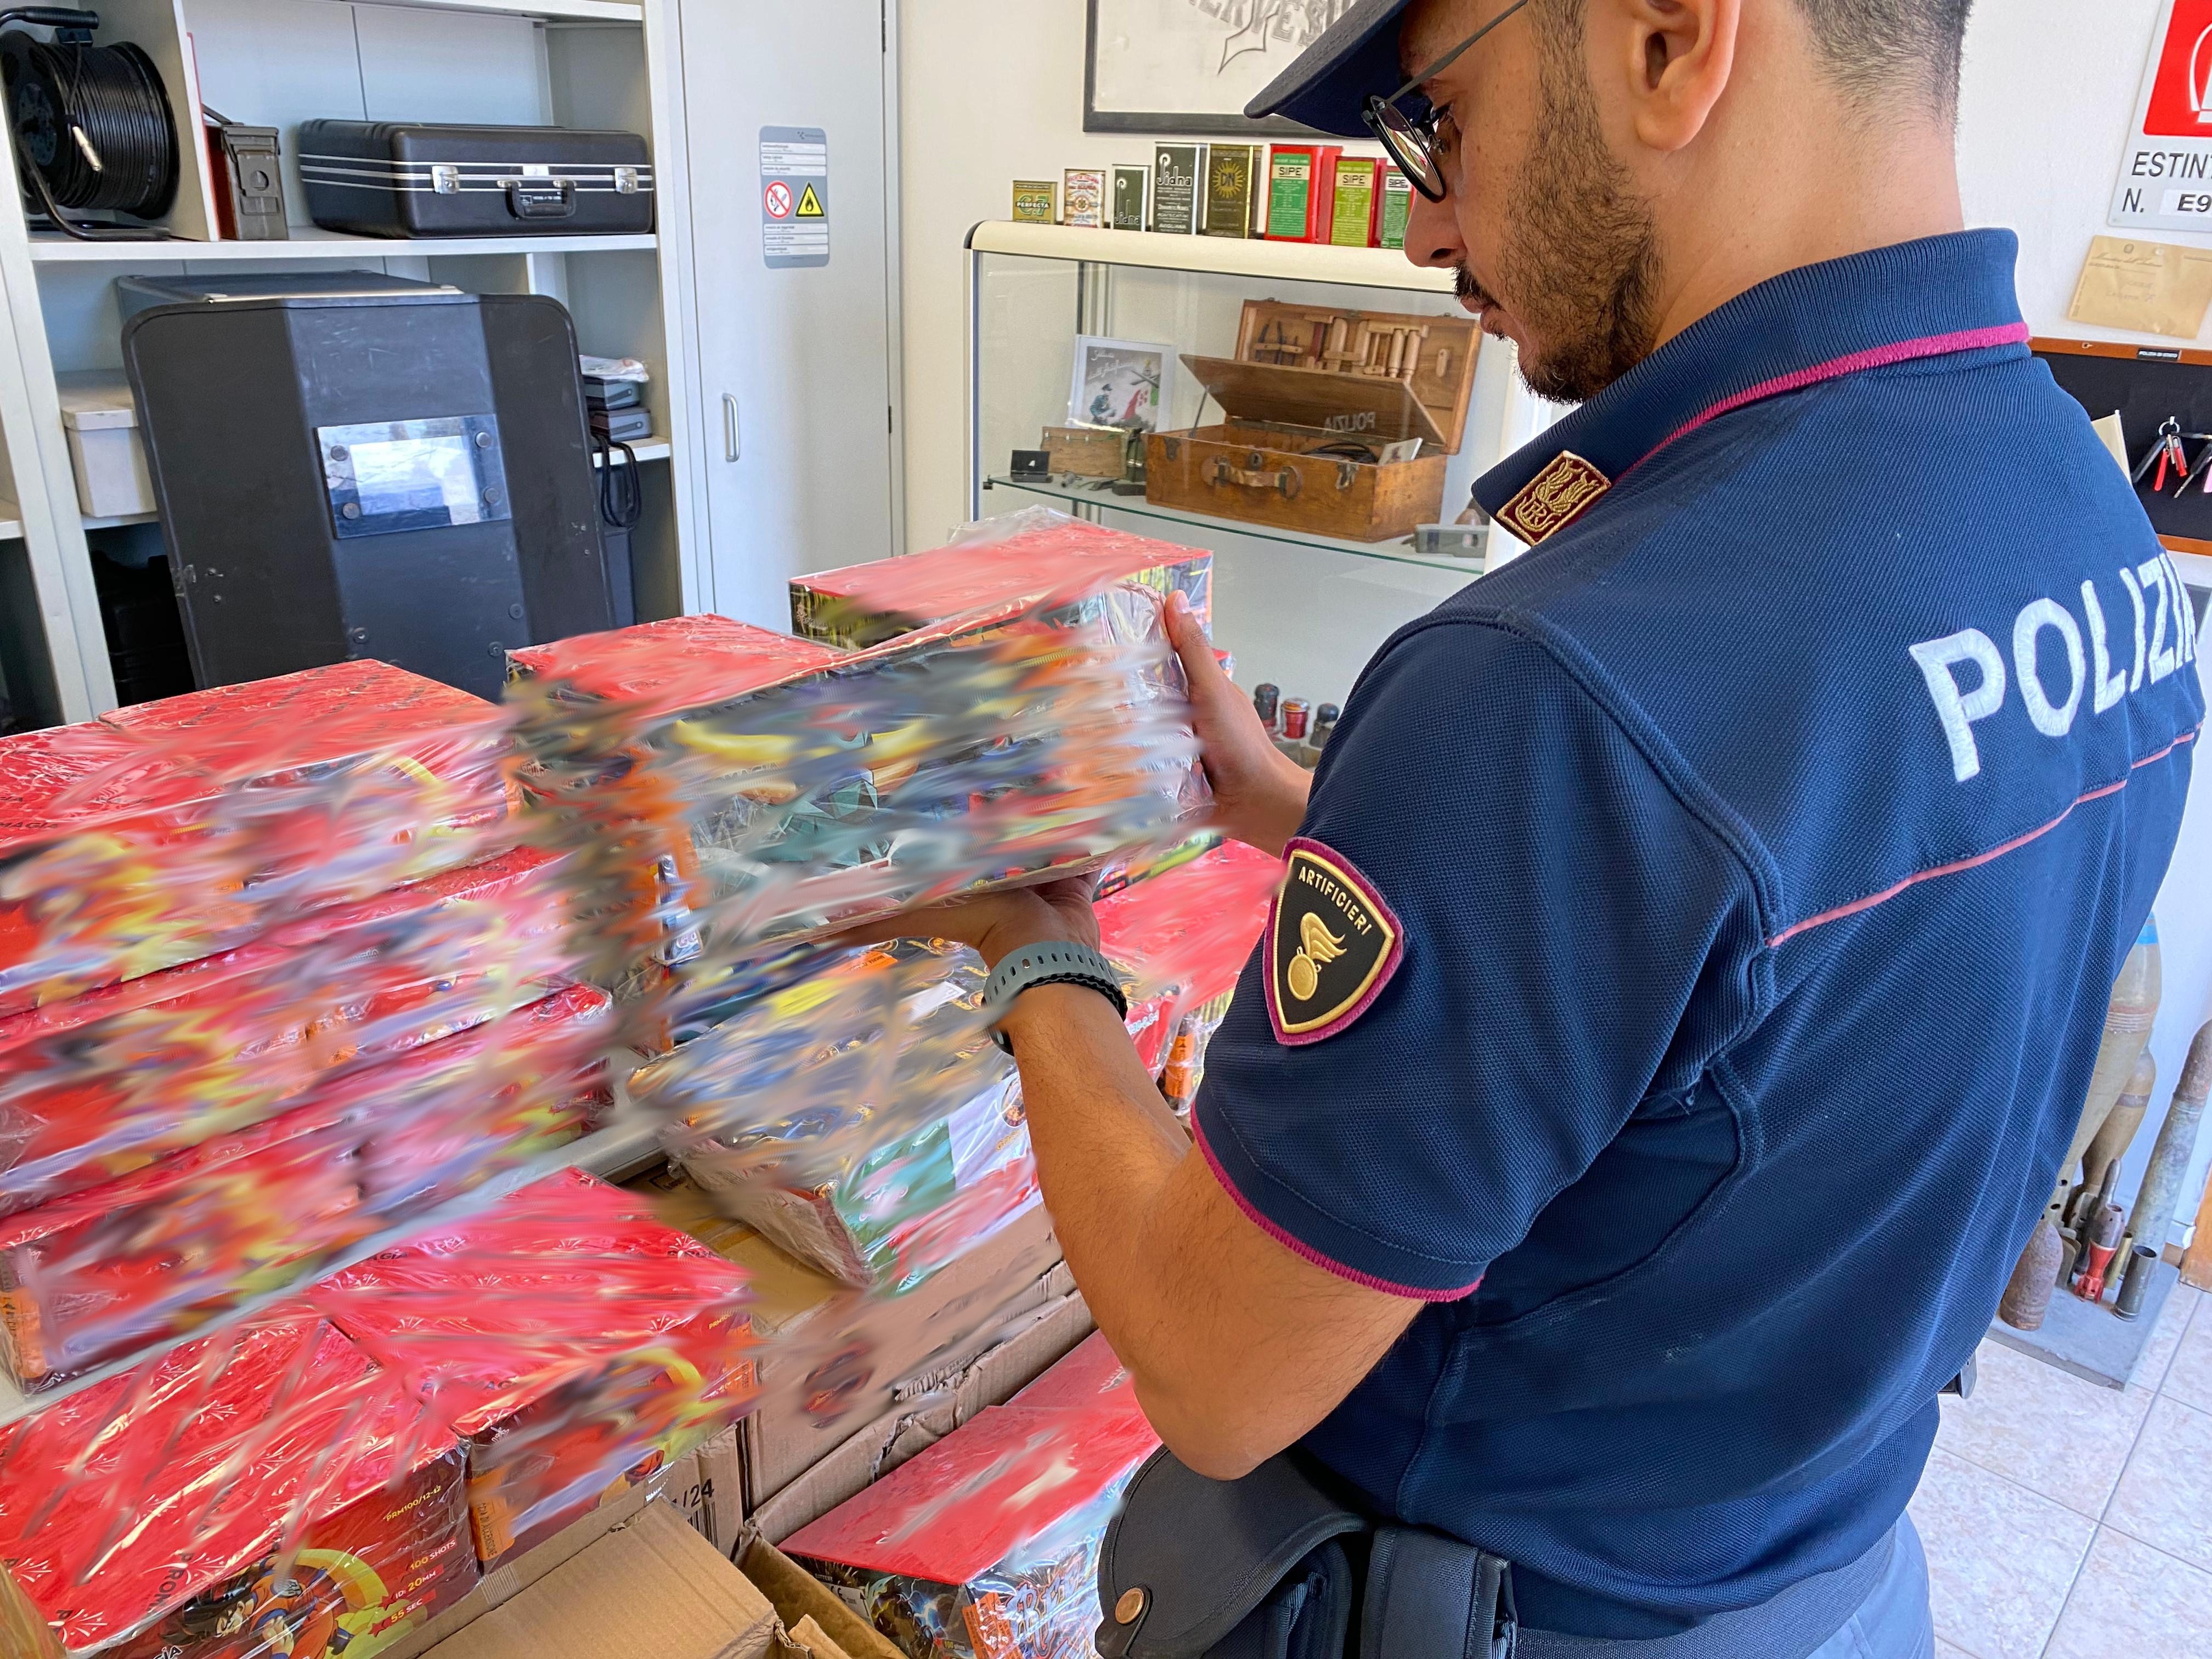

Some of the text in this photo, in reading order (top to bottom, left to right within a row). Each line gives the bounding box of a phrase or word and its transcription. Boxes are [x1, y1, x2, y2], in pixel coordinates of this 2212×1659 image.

[1279, 167, 1302, 176] SIPE
[2131, 151, 2212, 178] ESTIN
[1342, 174, 1365, 184] SIPE
[2122, 188, 2144, 213] N.
[1298, 866, 1372, 935] ARTIFICIERI
[410, 1543, 456, 1571] 100 SHOTS
[396, 1590, 406, 1599] ID:
[391, 1599, 422, 1623] 55 SEC
